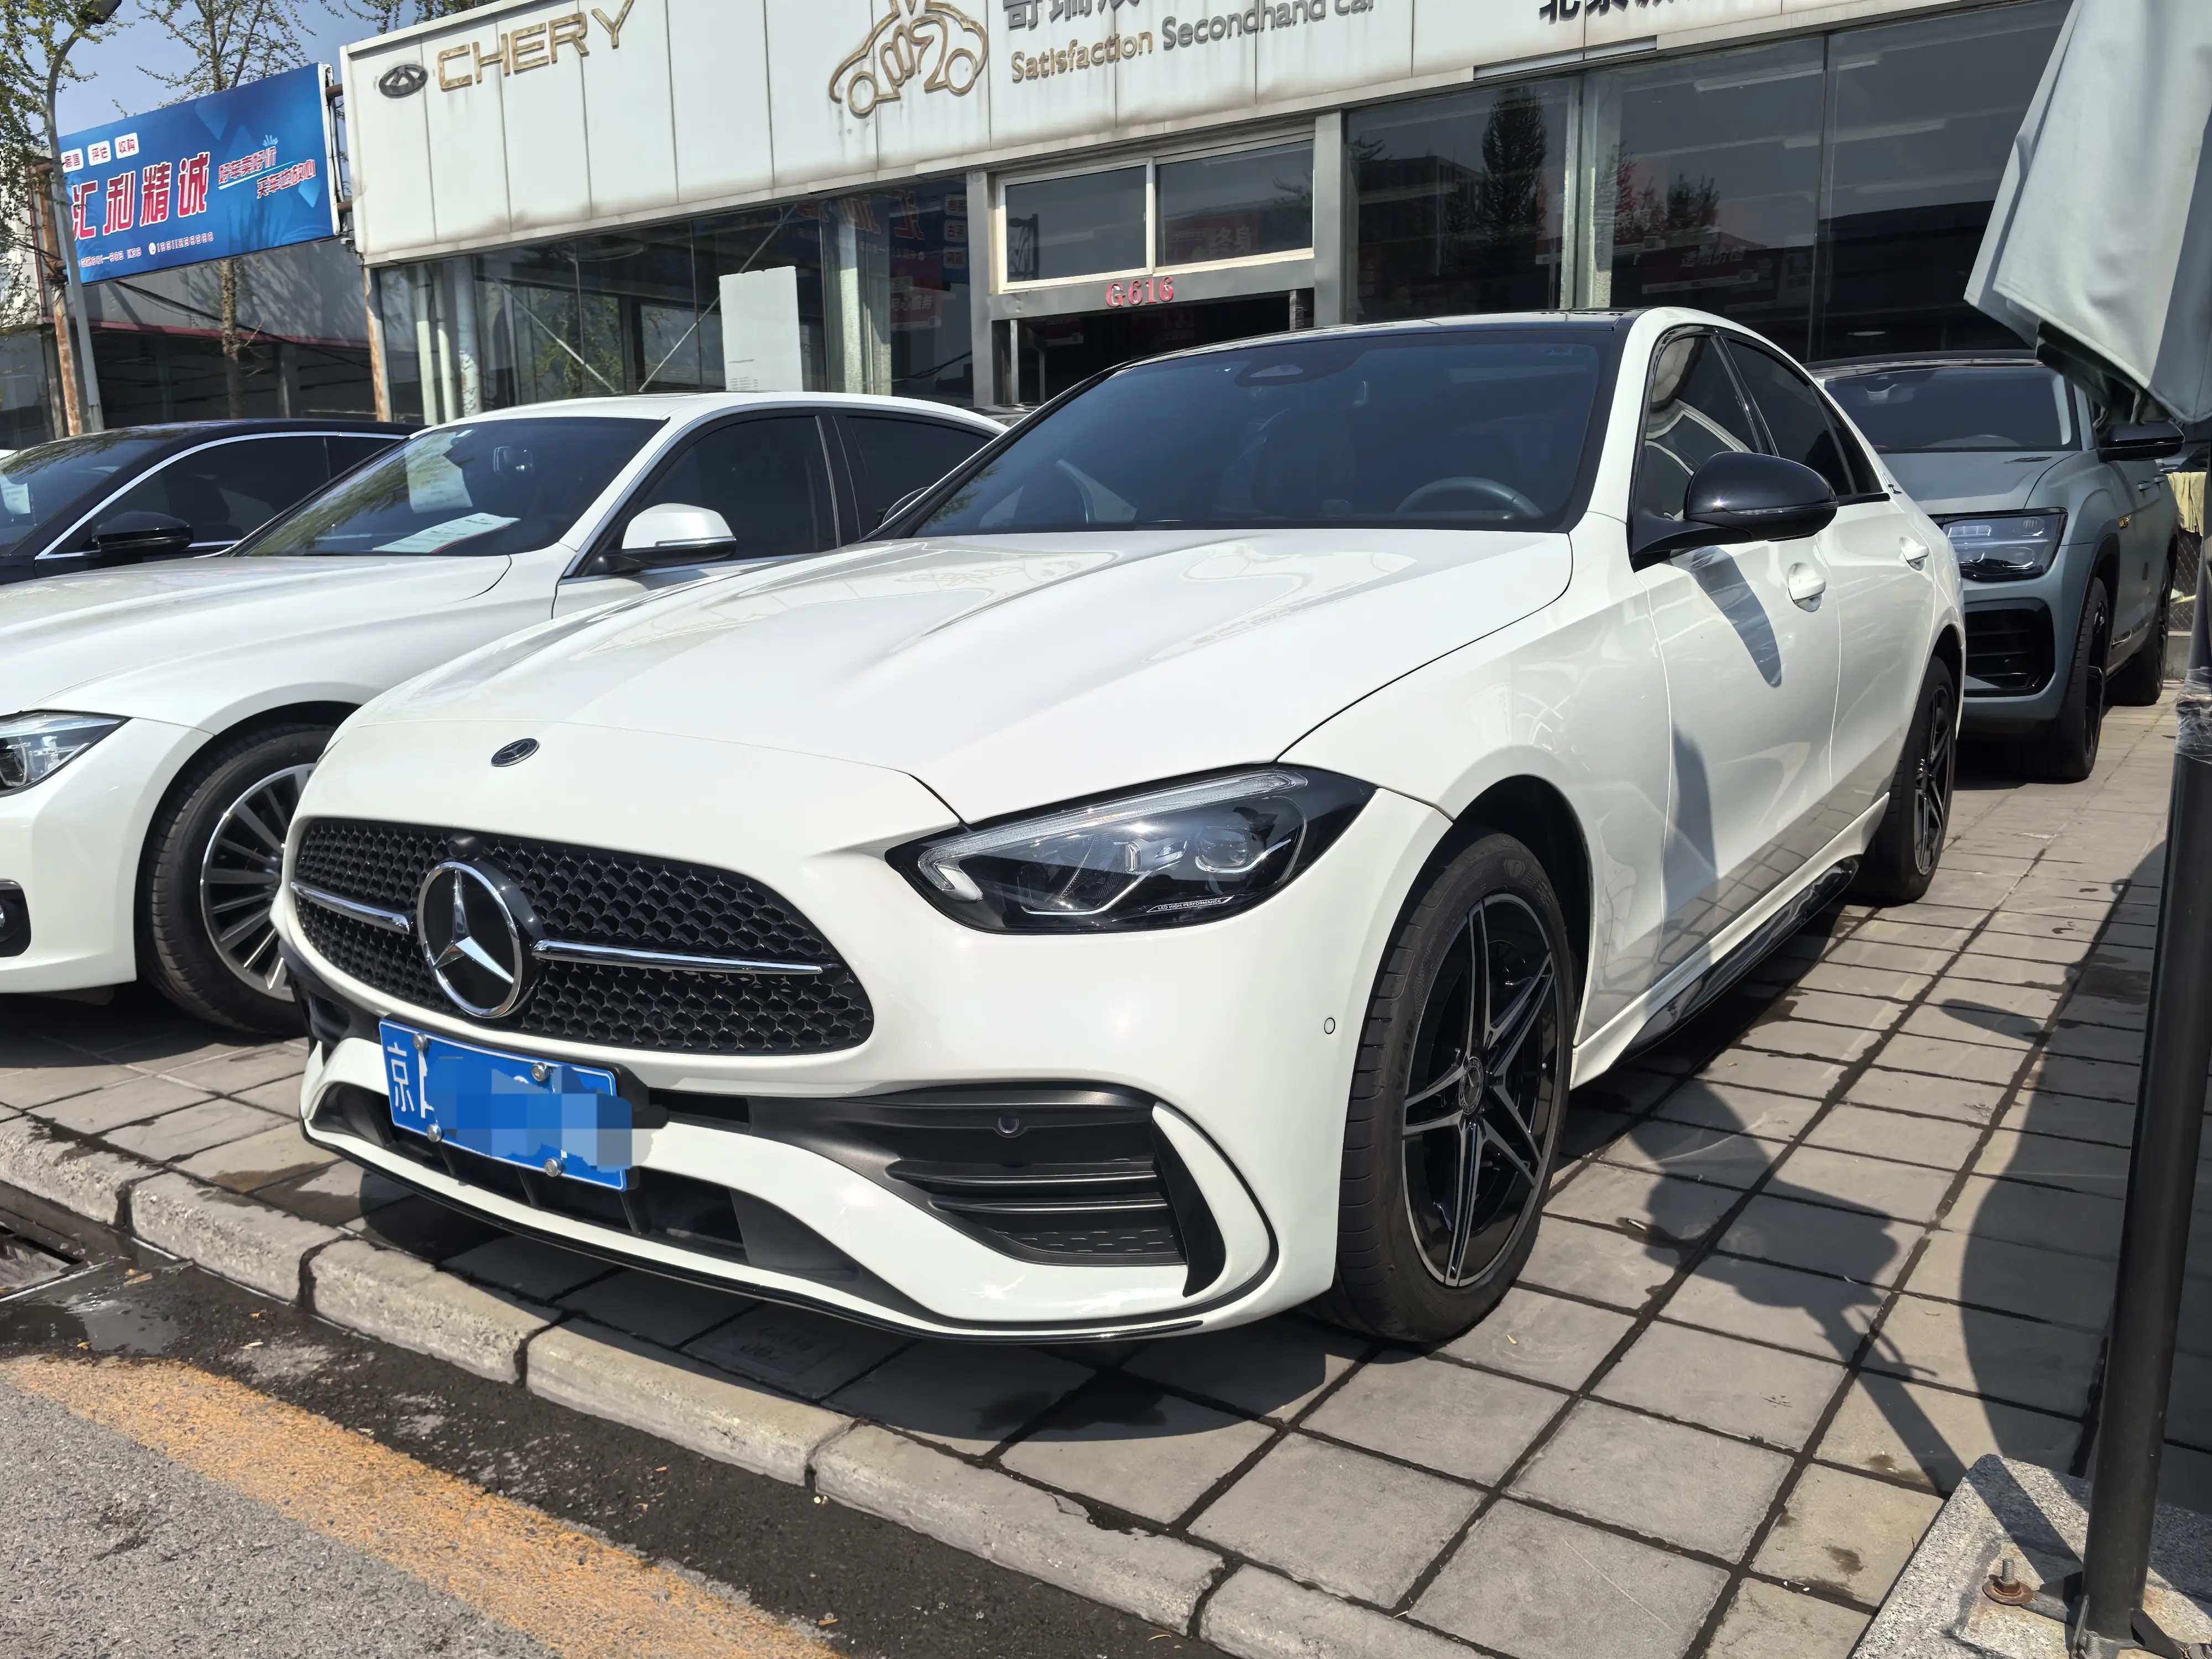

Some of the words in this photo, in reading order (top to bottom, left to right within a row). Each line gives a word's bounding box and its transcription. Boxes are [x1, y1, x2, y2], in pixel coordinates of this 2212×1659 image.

[437, 0, 634, 92] CHERY
[1011, 32, 1153, 84] Satisfaction
[1162, 0, 1326, 51] Secondhand
[73, 152, 210, 241] 汇利精诚
[1106, 276, 1174, 307] G616
